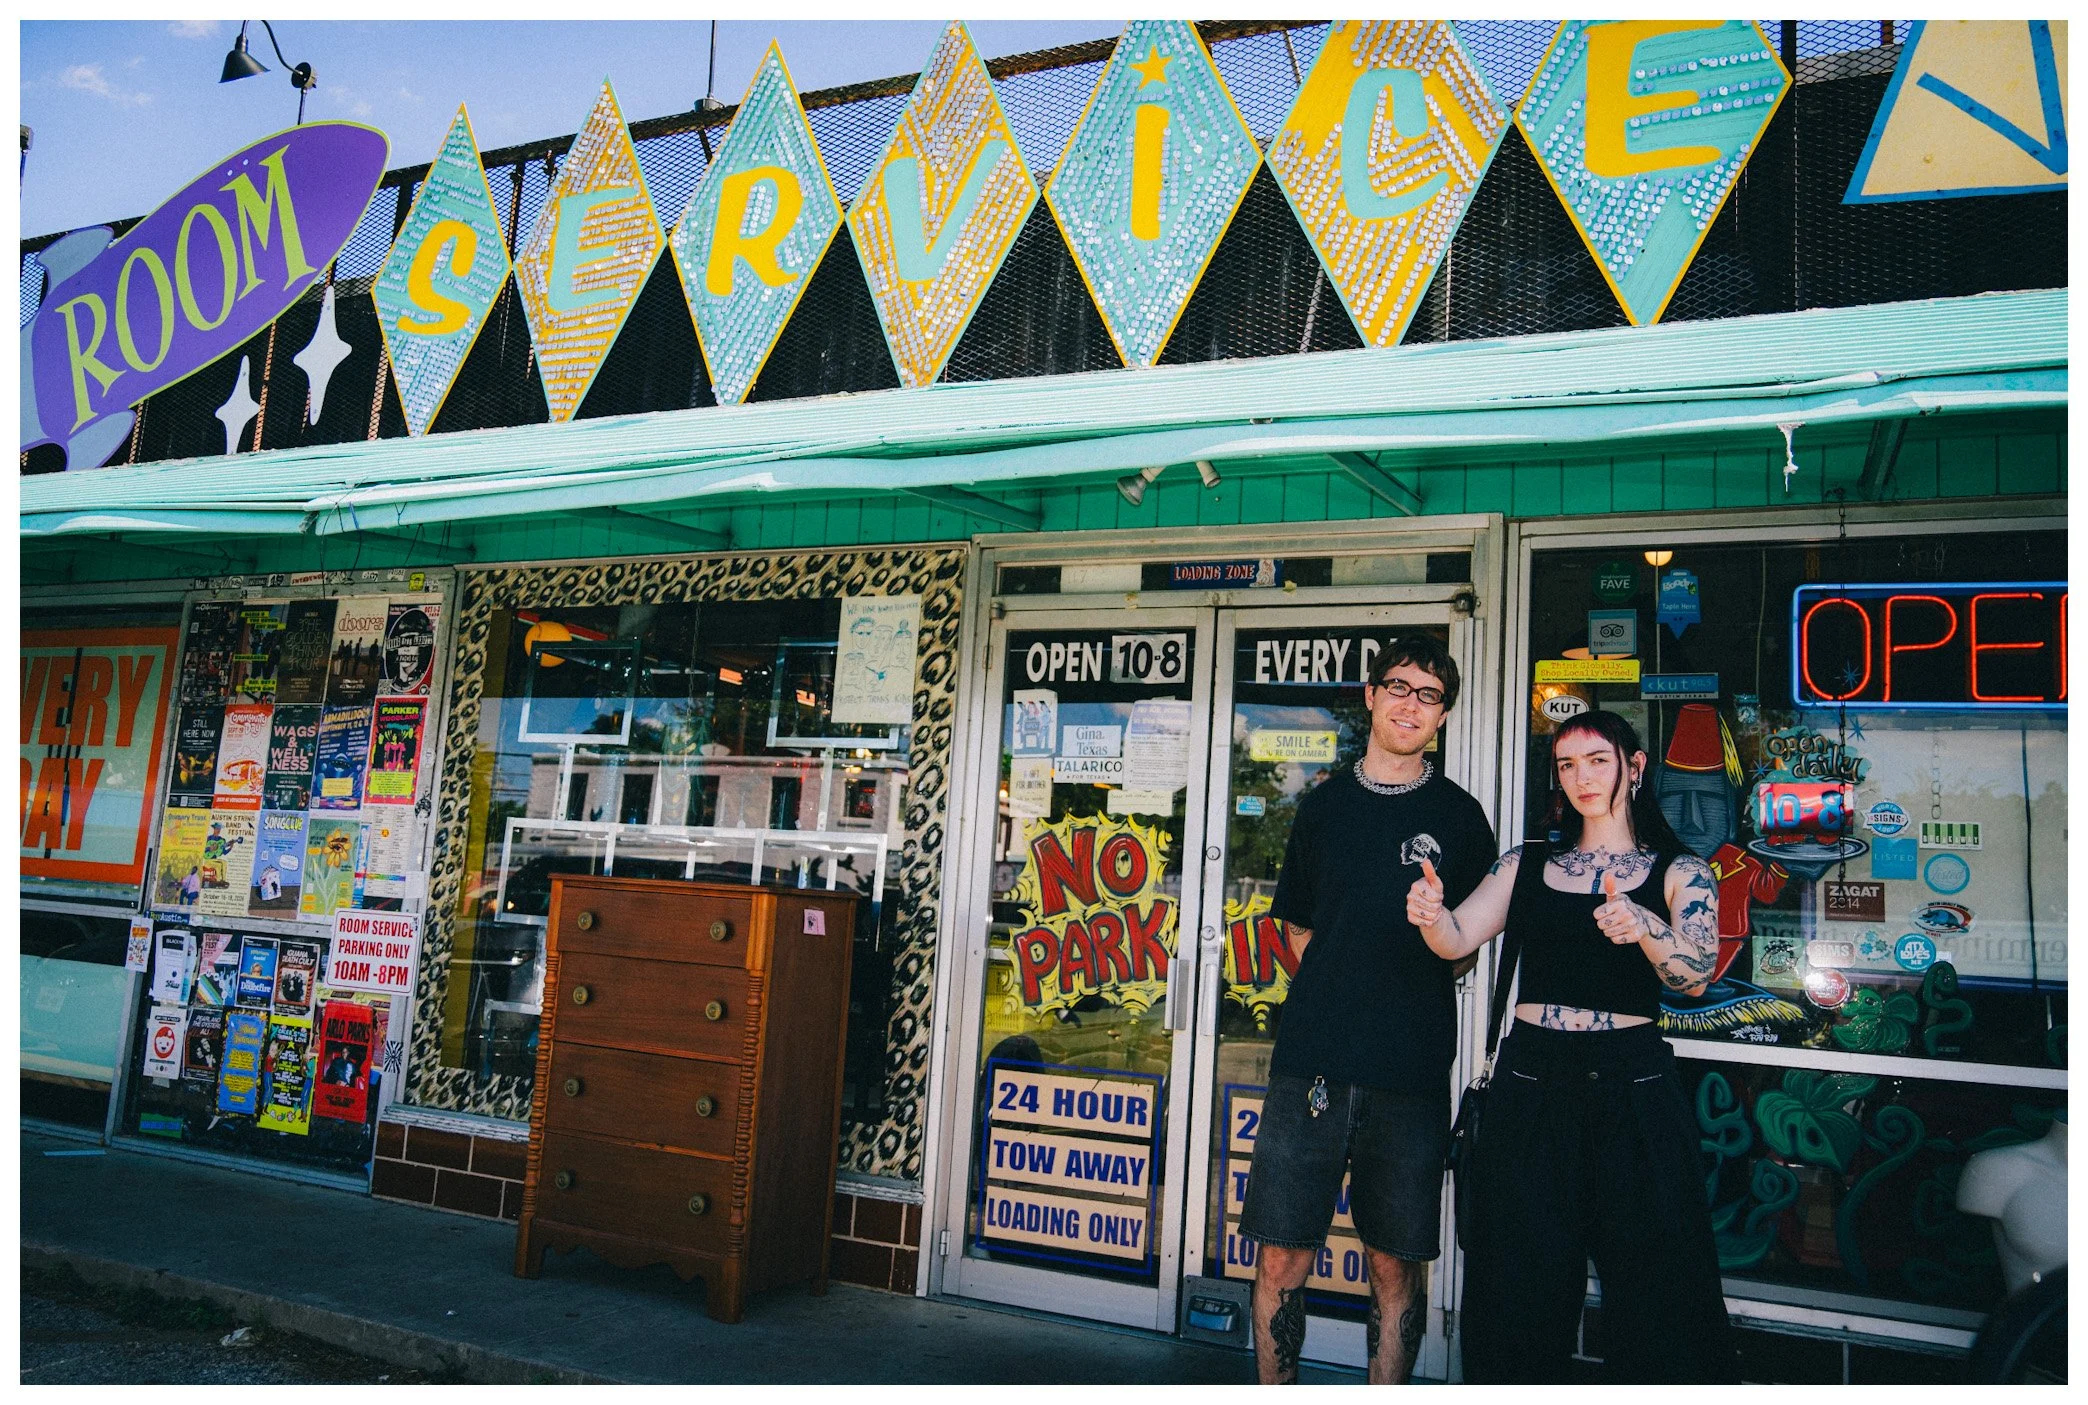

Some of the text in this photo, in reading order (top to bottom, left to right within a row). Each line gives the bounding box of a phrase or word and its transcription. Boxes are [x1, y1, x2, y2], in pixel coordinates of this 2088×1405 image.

[55, 143, 318, 433] ROOM
[398, 20, 1724, 336] SERVICE
[1173, 562, 1256, 582] LOADING ZONE
[1600, 579, 1631, 590] FAVE
[299, 618, 321, 632] THE
[338, 611, 385, 632] doors
[286, 631, 330, 645] GOLDEN
[1593, 640, 1630, 648] tripadvisor
[1801, 593, 2068, 702] OPE
[1026, 640, 1103, 683] OPEN
[1255, 638, 1358, 685] EVERY
[1580, 662, 1624, 670] Globally.
[1540, 669, 1562, 677] Shop
[1564, 669, 1599, 677] Locally
[1690, 679, 1712, 688] 90.5
[20, 656, 155, 747] VERY
[1550, 702, 1581, 714] KUT
[382, 706, 420, 714] PARKER
[192, 718, 208, 728] STILL
[230, 712, 268, 728] Community
[183, 730, 216, 738] HERE NOW
[245, 722, 261, 738] Day
[274, 726, 317, 738] WAGS
[1076, 726, 1105, 740] Gina
[288, 737, 298, 748] &
[1276, 736, 1311, 748] SMILE
[1766, 733, 1830, 761] open
[271, 748, 314, 759] WELL-
[1077, 743, 1108, 756] Texas
[272, 759, 310, 771] NESS
[1056, 760, 1123, 773] TALARICO
[1792, 745, 1865, 783] daily
[1764, 789, 1843, 831] 10-8
[1873, 814, 1902, 823] SIGNS
[1874, 854, 1915, 862] LISTED
[1031, 827, 1149, 917] NO
[1830, 885, 1880, 898] ZAGAT
[1830, 898, 1860, 909] 2014
[340, 918, 414, 939] ROOM SERVICE
[286, 949, 309, 958] IGUANA
[338, 939, 410, 960] PARKING ONLY
[1013, 899, 1302, 1008] PARK IN
[1816, 946, 1850, 957] SIMS
[1904, 942, 1925, 951] ATX
[282, 956, 316, 966] DEATH CULT
[334, 960, 370, 982] 10AM
[326, 1018, 346, 1039] ARLO
[346, 1020, 371, 1044] PARKS
[998, 1082, 1148, 1126] 24 HOUR
[1236, 1109, 1260, 1141] 2
[993, 1139, 1146, 1187] TOW AWAY
[986, 1197, 1144, 1248] LOADING ONLY
